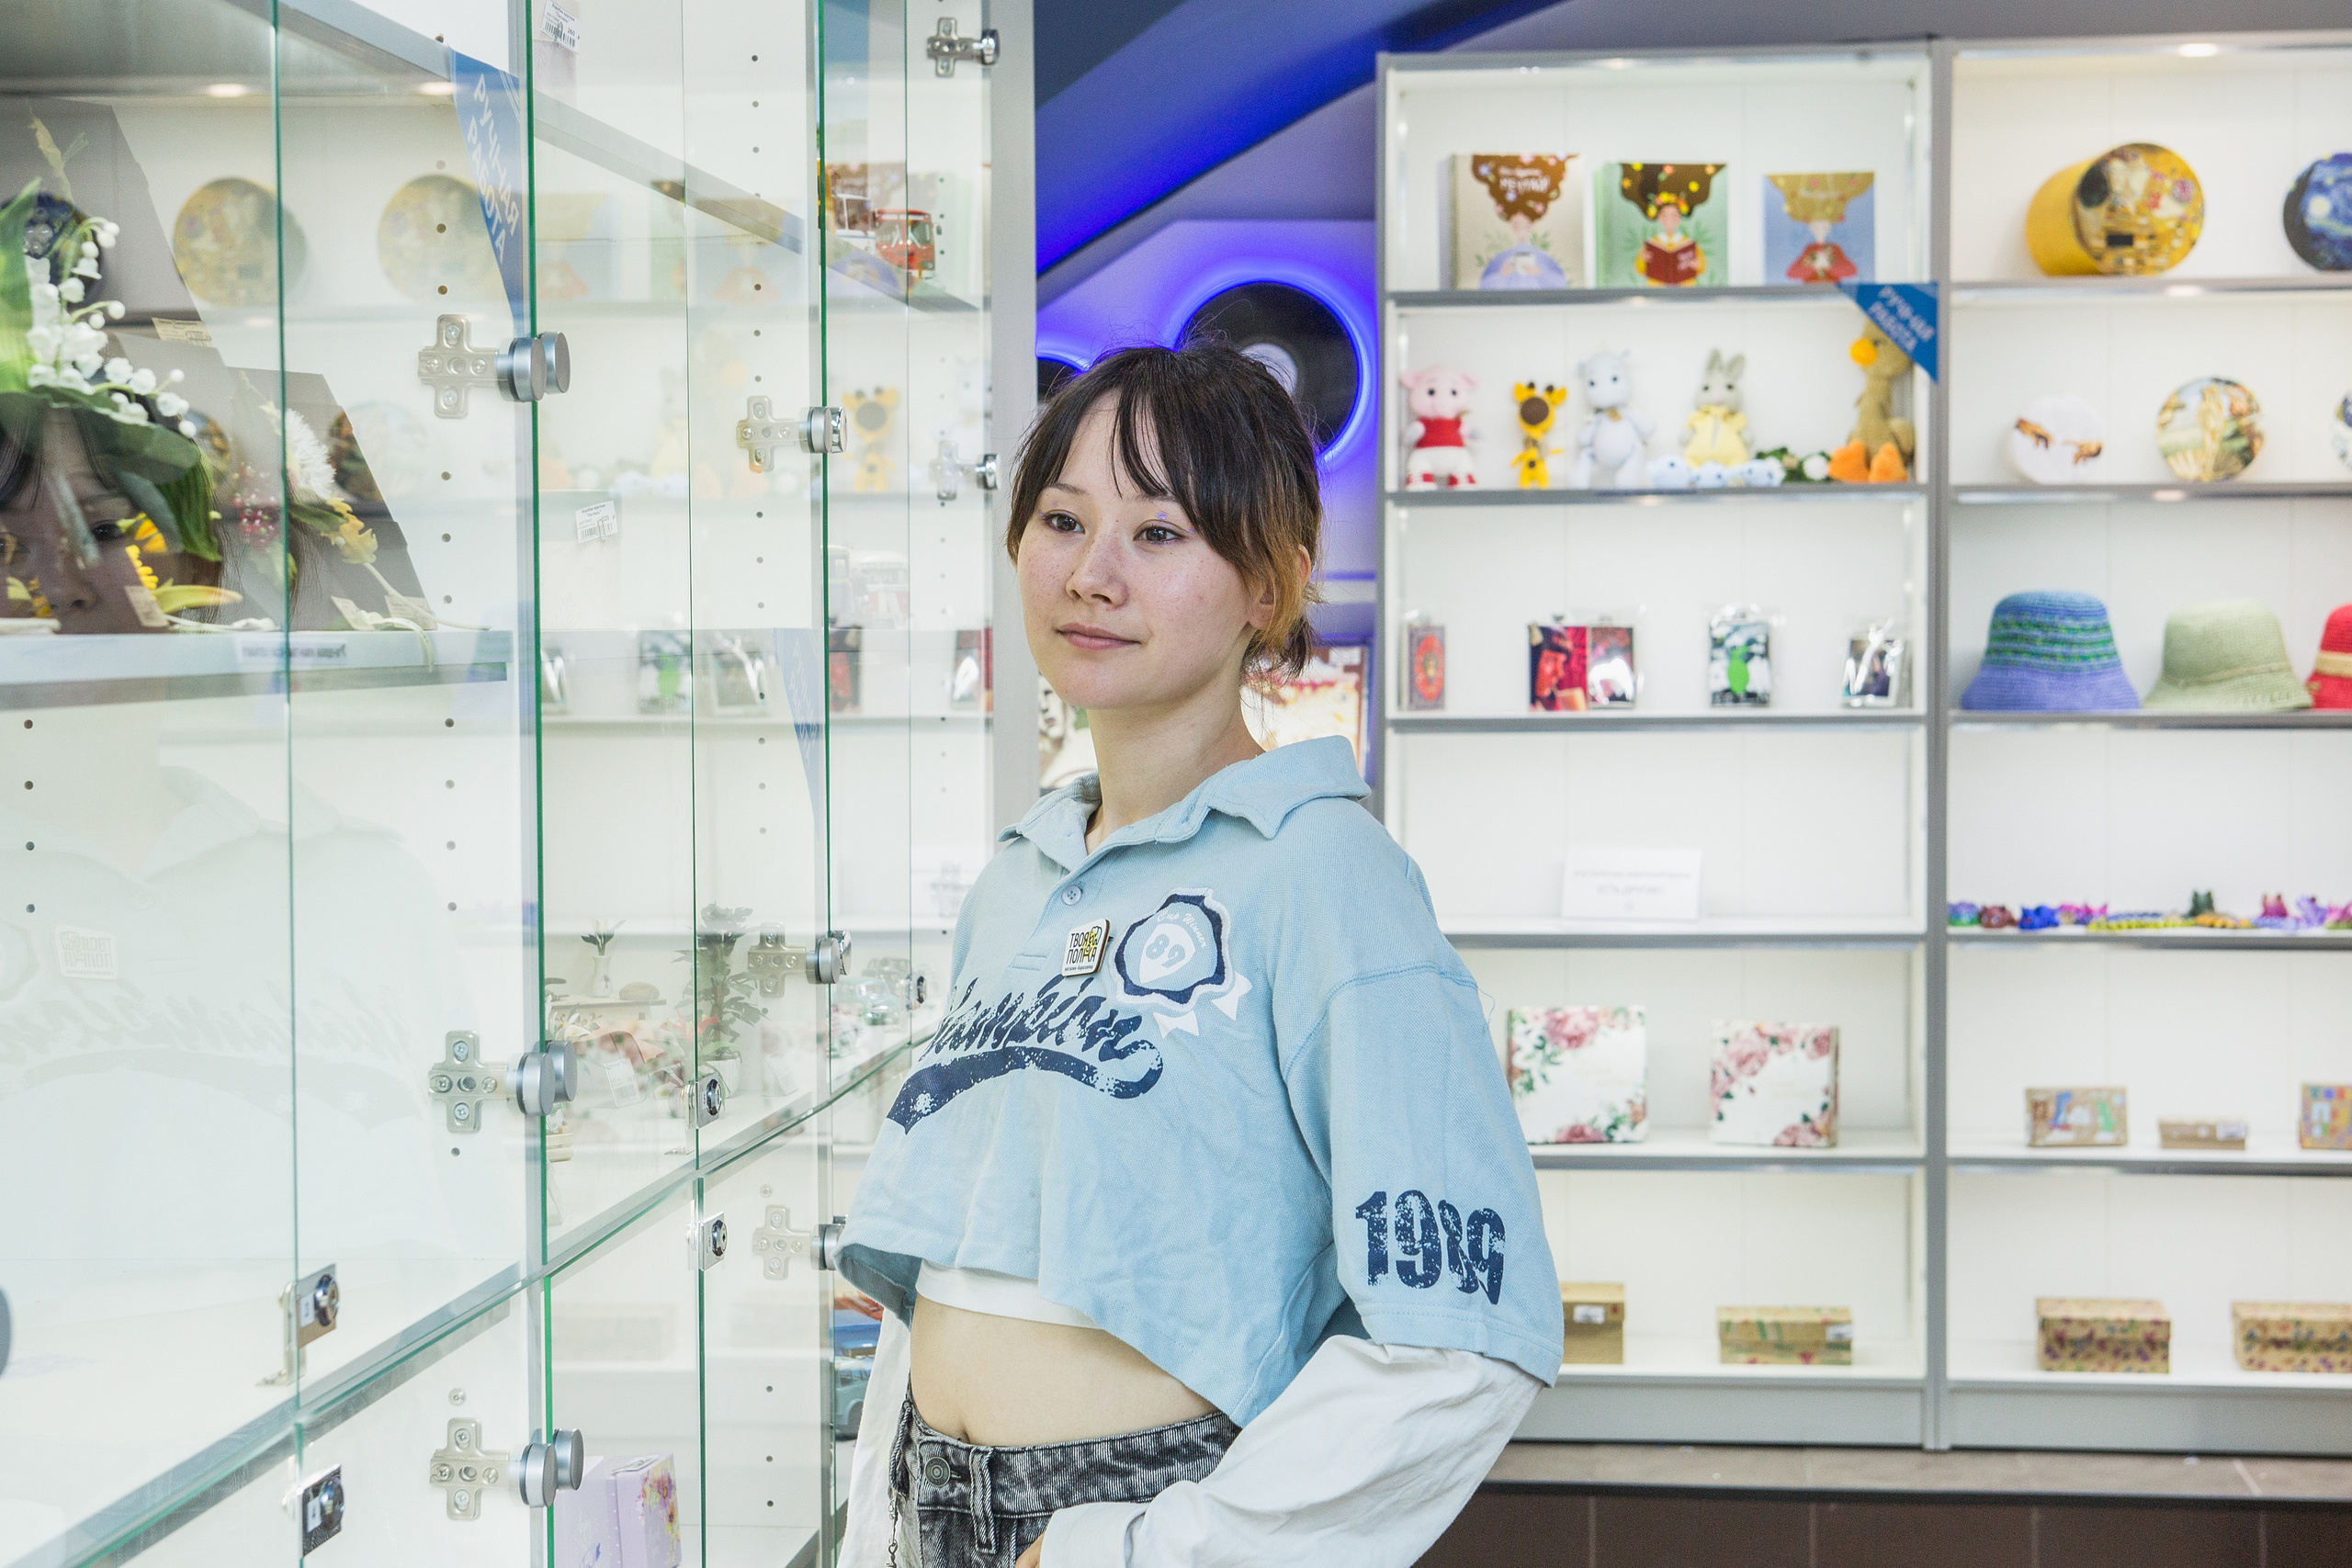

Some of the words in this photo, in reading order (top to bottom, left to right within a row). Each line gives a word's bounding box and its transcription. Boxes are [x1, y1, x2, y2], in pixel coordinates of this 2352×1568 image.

[473, 73, 520, 237] РУЧНАЯ
[467, 115, 506, 265] РАБОТА
[1069, 931, 1090, 948] ТВОЯ
[1157, 909, 1181, 922] Cup
[1182, 912, 1207, 949] Winner
[1145, 933, 1186, 969] 89
